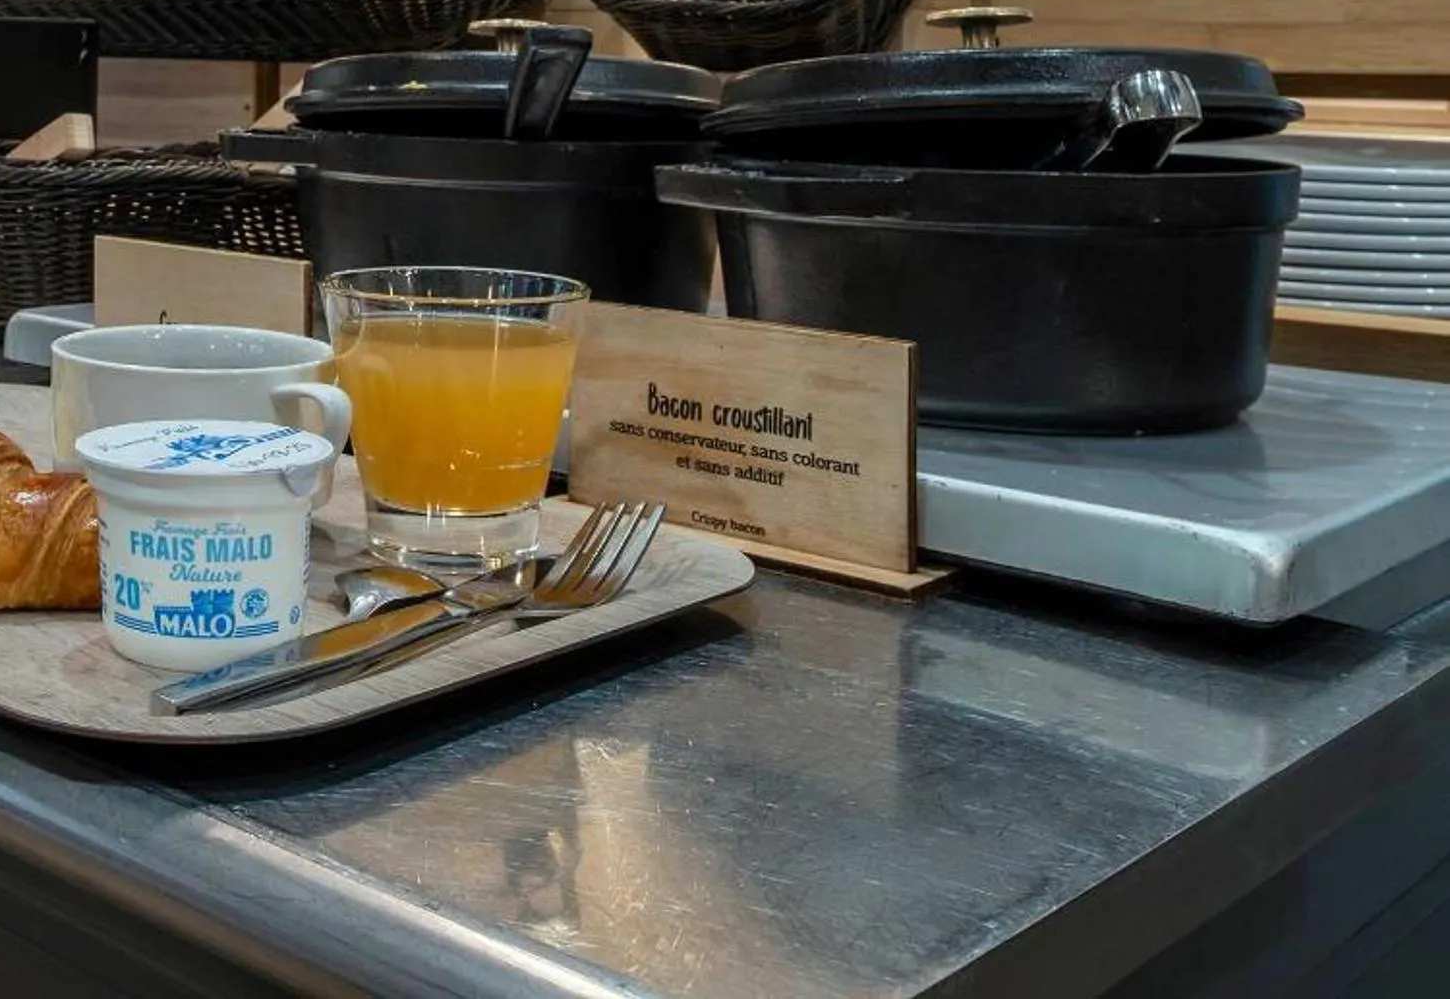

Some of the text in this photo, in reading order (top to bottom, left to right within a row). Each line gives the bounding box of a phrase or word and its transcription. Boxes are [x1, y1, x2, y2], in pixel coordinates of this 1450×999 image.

[646, 381, 813, 442] Bacon croustillant
[609, 420, 861, 477] sans conservateur, sans colorant
[675, 454, 786, 487] et sans additif
[691, 510, 766, 537] Crispy bacon
[130, 530, 195, 563] FRAIS
[206, 533, 273, 563] MALO
[169, 563, 244, 583] Nature
[159, 612, 234, 638] MALO
